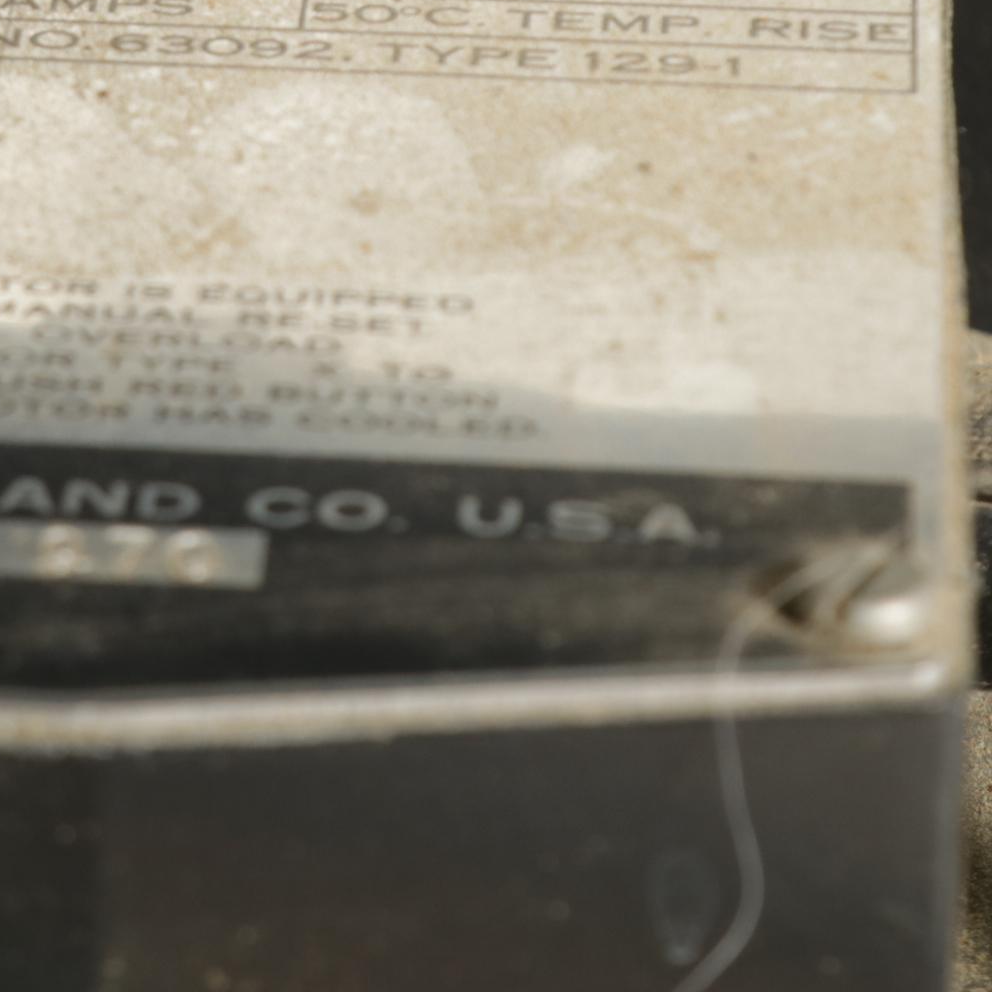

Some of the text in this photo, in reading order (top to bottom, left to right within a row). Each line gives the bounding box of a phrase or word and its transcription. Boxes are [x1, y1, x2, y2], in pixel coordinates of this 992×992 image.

[747, 16, 910, 43] RISE
[376, 41, 558, 71] TYPE
[584, 51, 742, 77] 129-1
[196, 282, 477, 315] EQUIPPED
